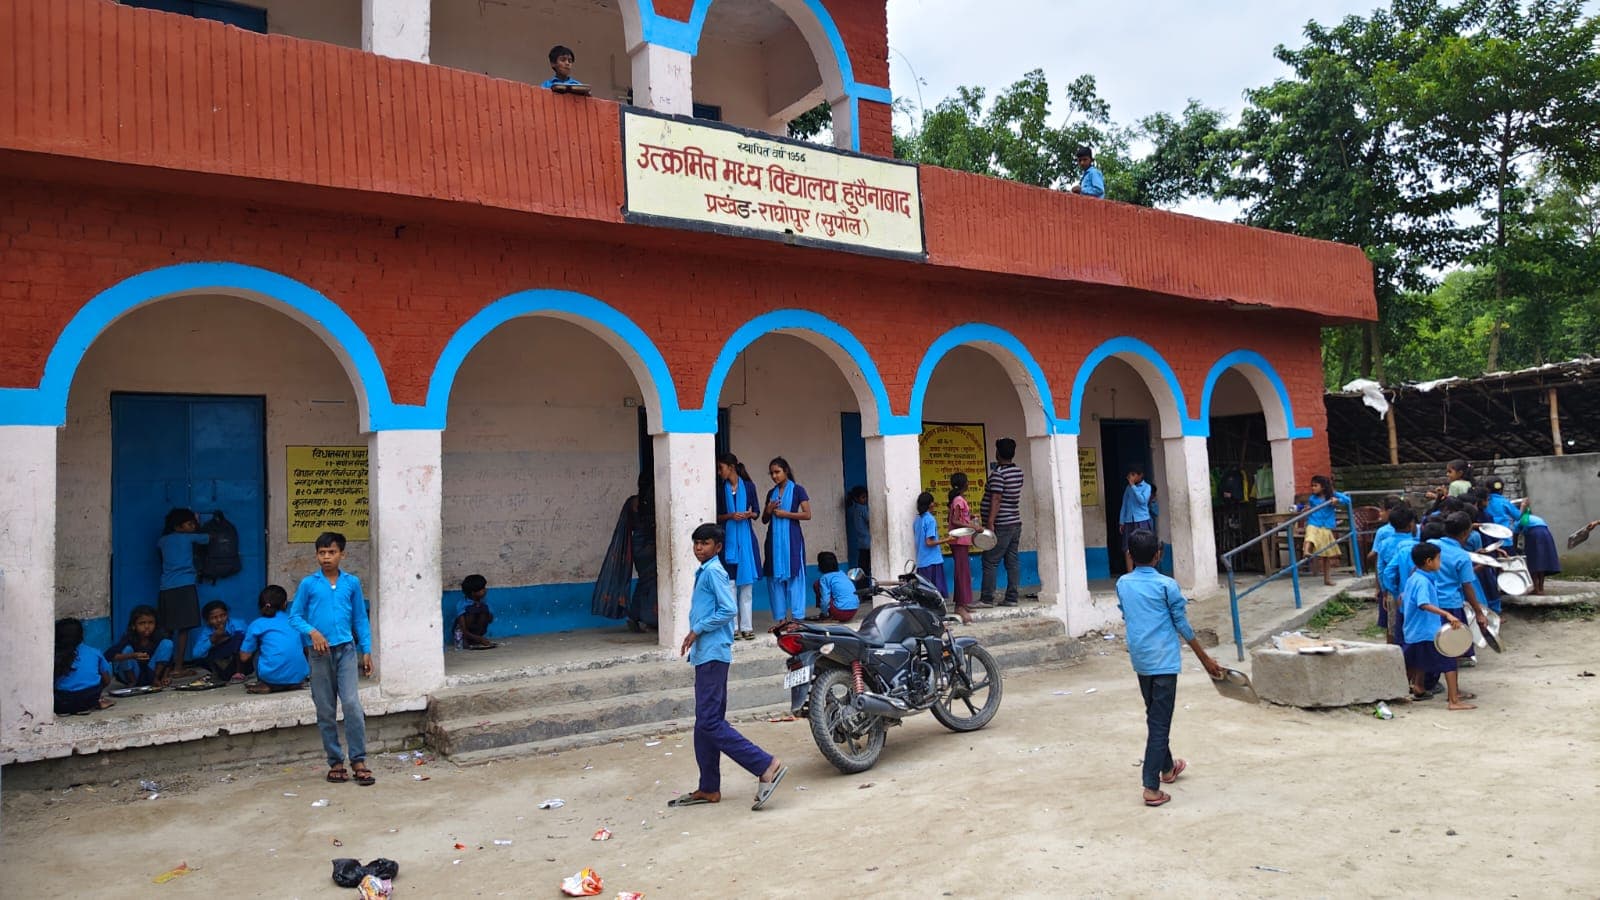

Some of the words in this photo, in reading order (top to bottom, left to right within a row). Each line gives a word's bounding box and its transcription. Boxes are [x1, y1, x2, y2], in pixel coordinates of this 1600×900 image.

[737, 142, 769, 157] स्थापित
[771, 146, 786, 159] वर्ष
[637, 143, 718, 181] उत्क्रमित
[722, 158, 763, 190] मध्य
[766, 164, 837, 204] विद्यालय
[841, 178, 912, 219] हुसैनाबाद
[815, 210, 869, 237] (सुपौल)
